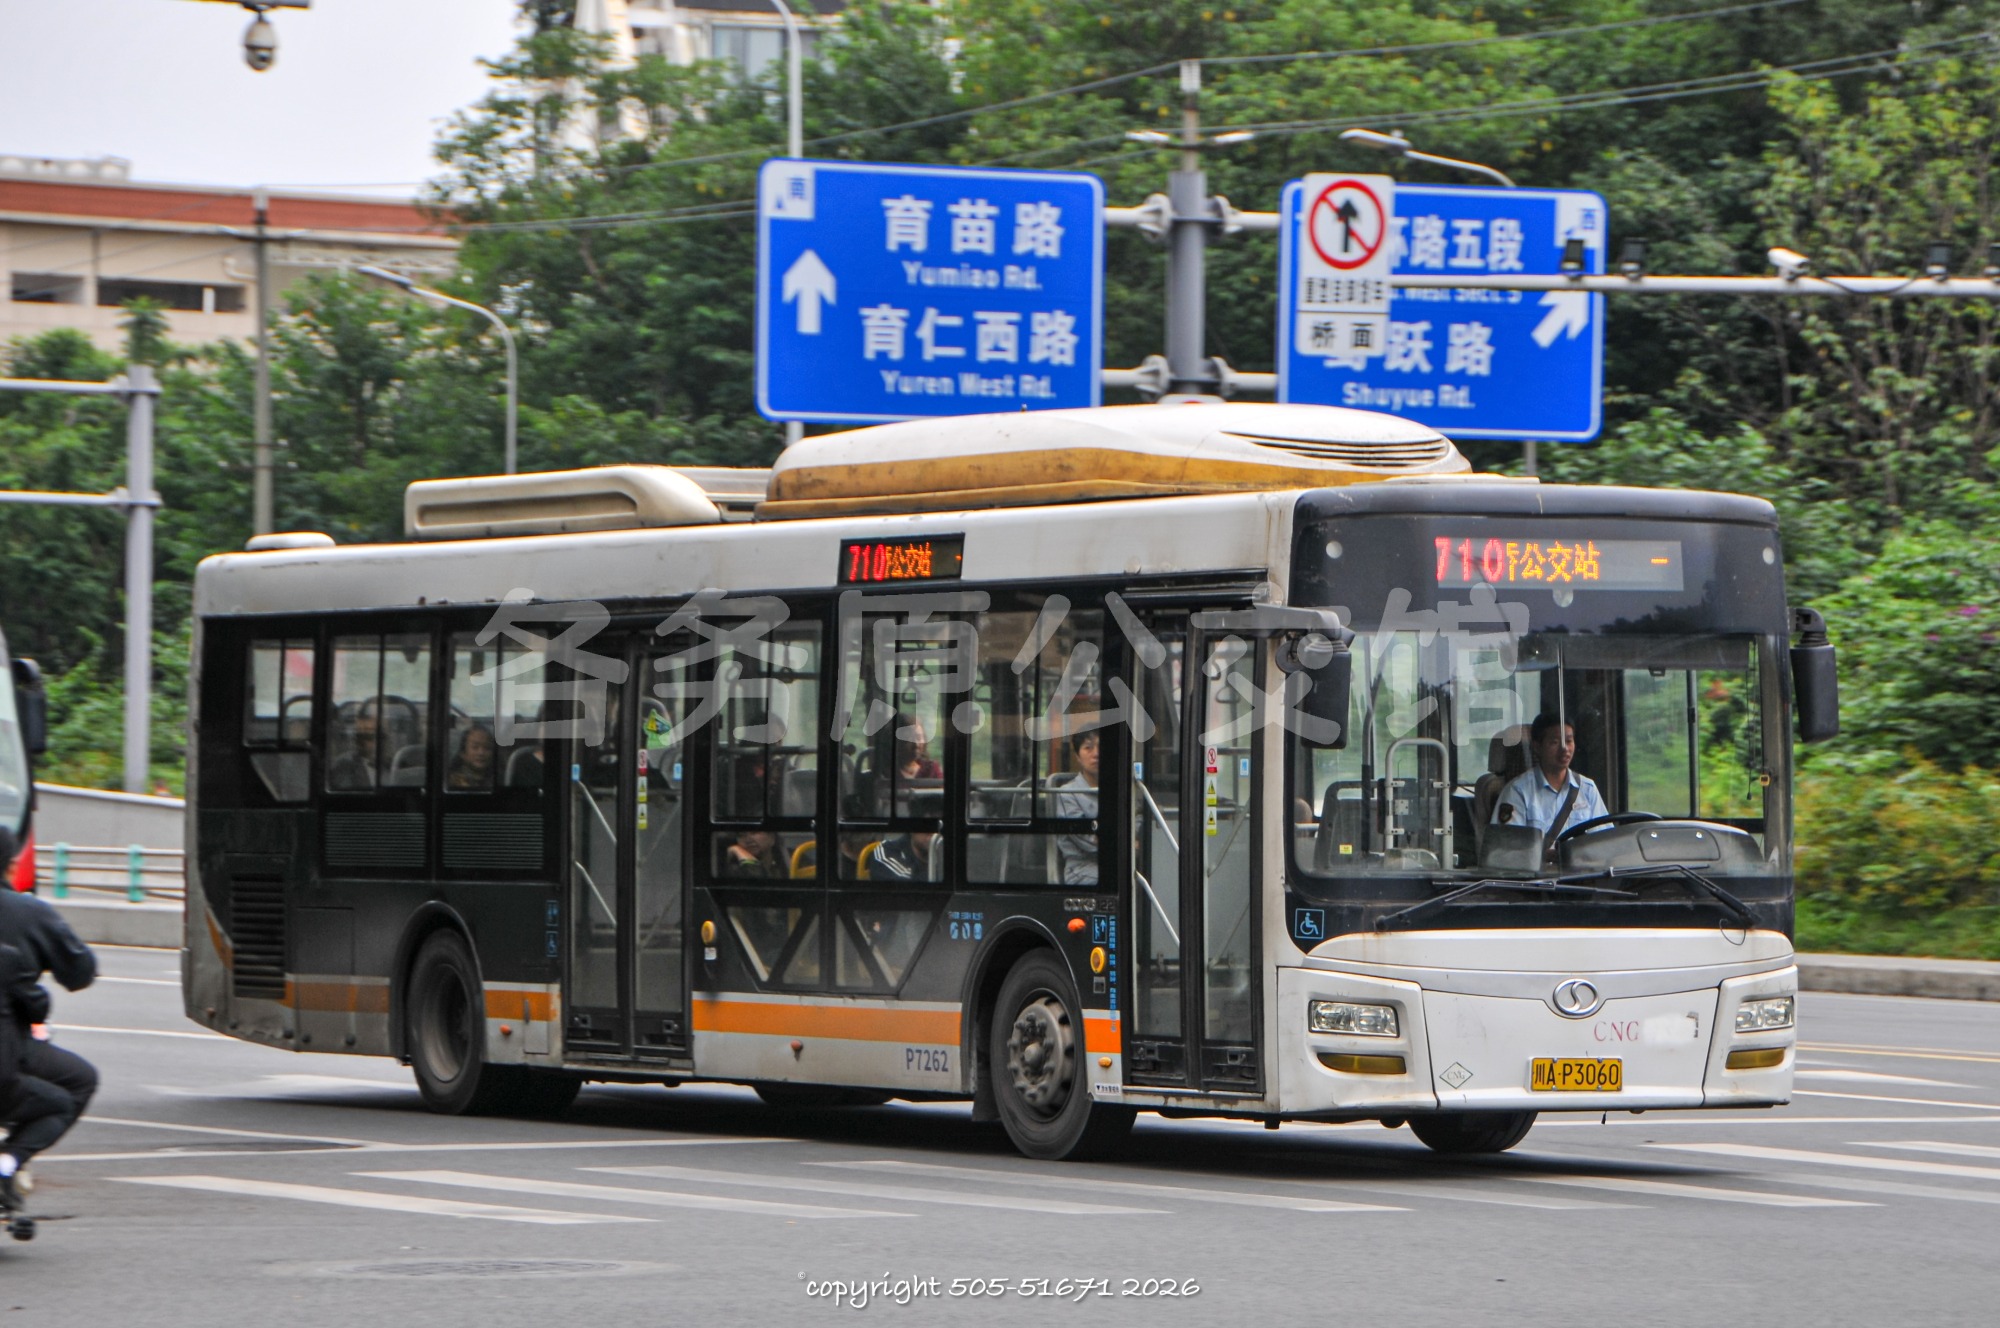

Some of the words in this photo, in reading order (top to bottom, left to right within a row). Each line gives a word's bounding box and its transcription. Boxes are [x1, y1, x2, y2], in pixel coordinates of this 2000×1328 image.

[881, 195, 1065, 258] 育苗路
[902, 260, 999, 288] Yumiao
[1003, 264, 1042, 290] Rd.
[859, 303, 1079, 367] 育仁西路
[1323, 320, 1495, 376] 跃路
[880, 370, 954, 396] Yuren
[959, 373, 1015, 397] West
[1020, 374, 1056, 399] Rd.
[1342, 381, 1434, 410] Shuyue
[1438, 384, 1476, 408] Rd.
[848, 543, 886, 582] 710
[1434, 536, 1503, 582] 710
[1594, 1021, 1639, 1042] CNG
[906, 1047, 949, 1072] P7262
